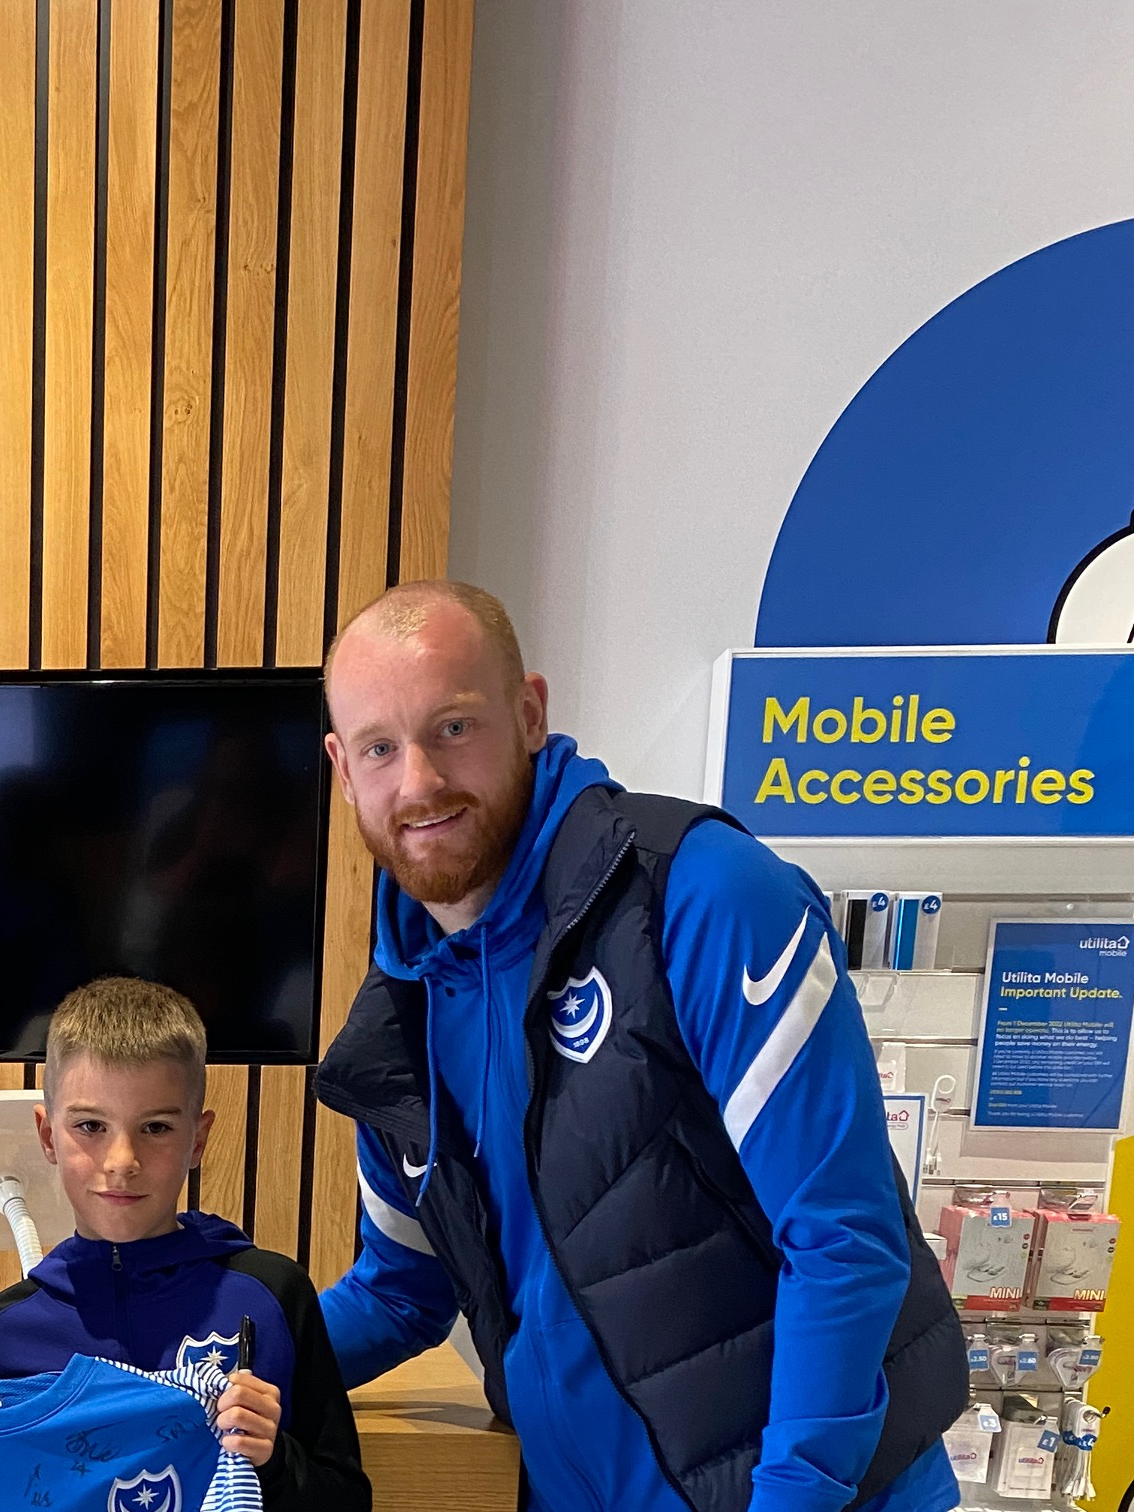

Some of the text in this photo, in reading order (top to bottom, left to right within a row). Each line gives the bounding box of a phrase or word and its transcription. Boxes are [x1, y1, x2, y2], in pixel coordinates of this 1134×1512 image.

[761, 694, 956, 744] Mobile
[754, 756, 1095, 805] Accessories
[923, 899, 938, 910] £4
[1079, 938, 1116, 949] utilita
[1002, 971, 1089, 984] Utilita Mobile
[1000, 986, 1123, 1000] Important Update.
[989, 1287, 1020, 1299] MINI
[1073, 1289, 1105, 1300] MINI
